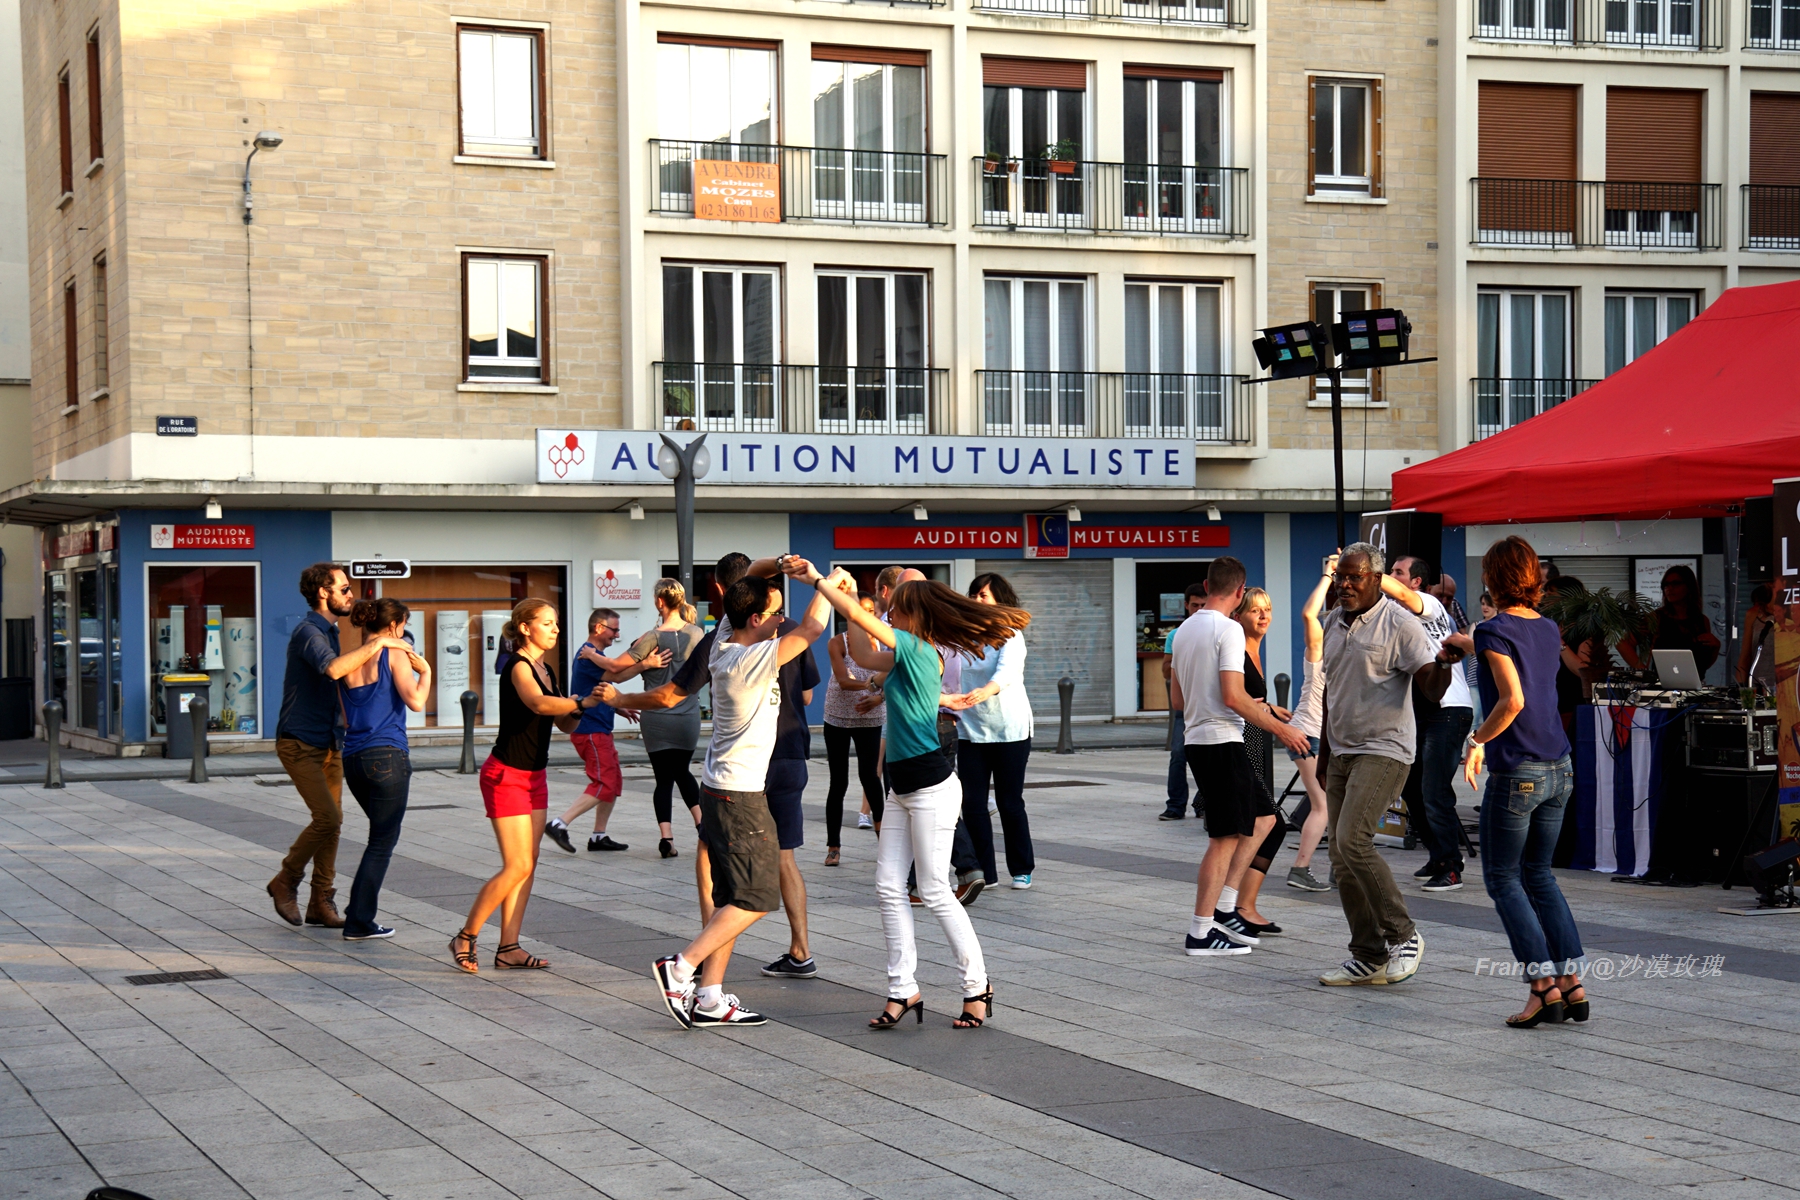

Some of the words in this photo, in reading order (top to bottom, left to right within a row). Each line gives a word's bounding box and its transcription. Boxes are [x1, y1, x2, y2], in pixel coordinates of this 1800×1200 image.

[699, 163, 708, 176] A
[713, 163, 776, 179] VENDRE
[711, 179, 764, 187] Cabinet
[701, 187, 775, 198] MOZES
[724, 197, 752, 205] Caen
[701, 203, 713, 216] 02
[717, 204, 728, 217] 31
[732, 205, 745, 218] 86
[749, 206, 759, 219] 11
[763, 206, 776, 220] 65
[611, 442, 855, 473] AUITION
[895, 446, 1179, 476] MUTUALISTE
[187, 528, 246, 536] AUDITION
[914, 531, 1017, 545] AUDITION
[1074, 530, 1200, 543] MUTUALISTE
[177, 537, 251, 545] MUTUALISTE
